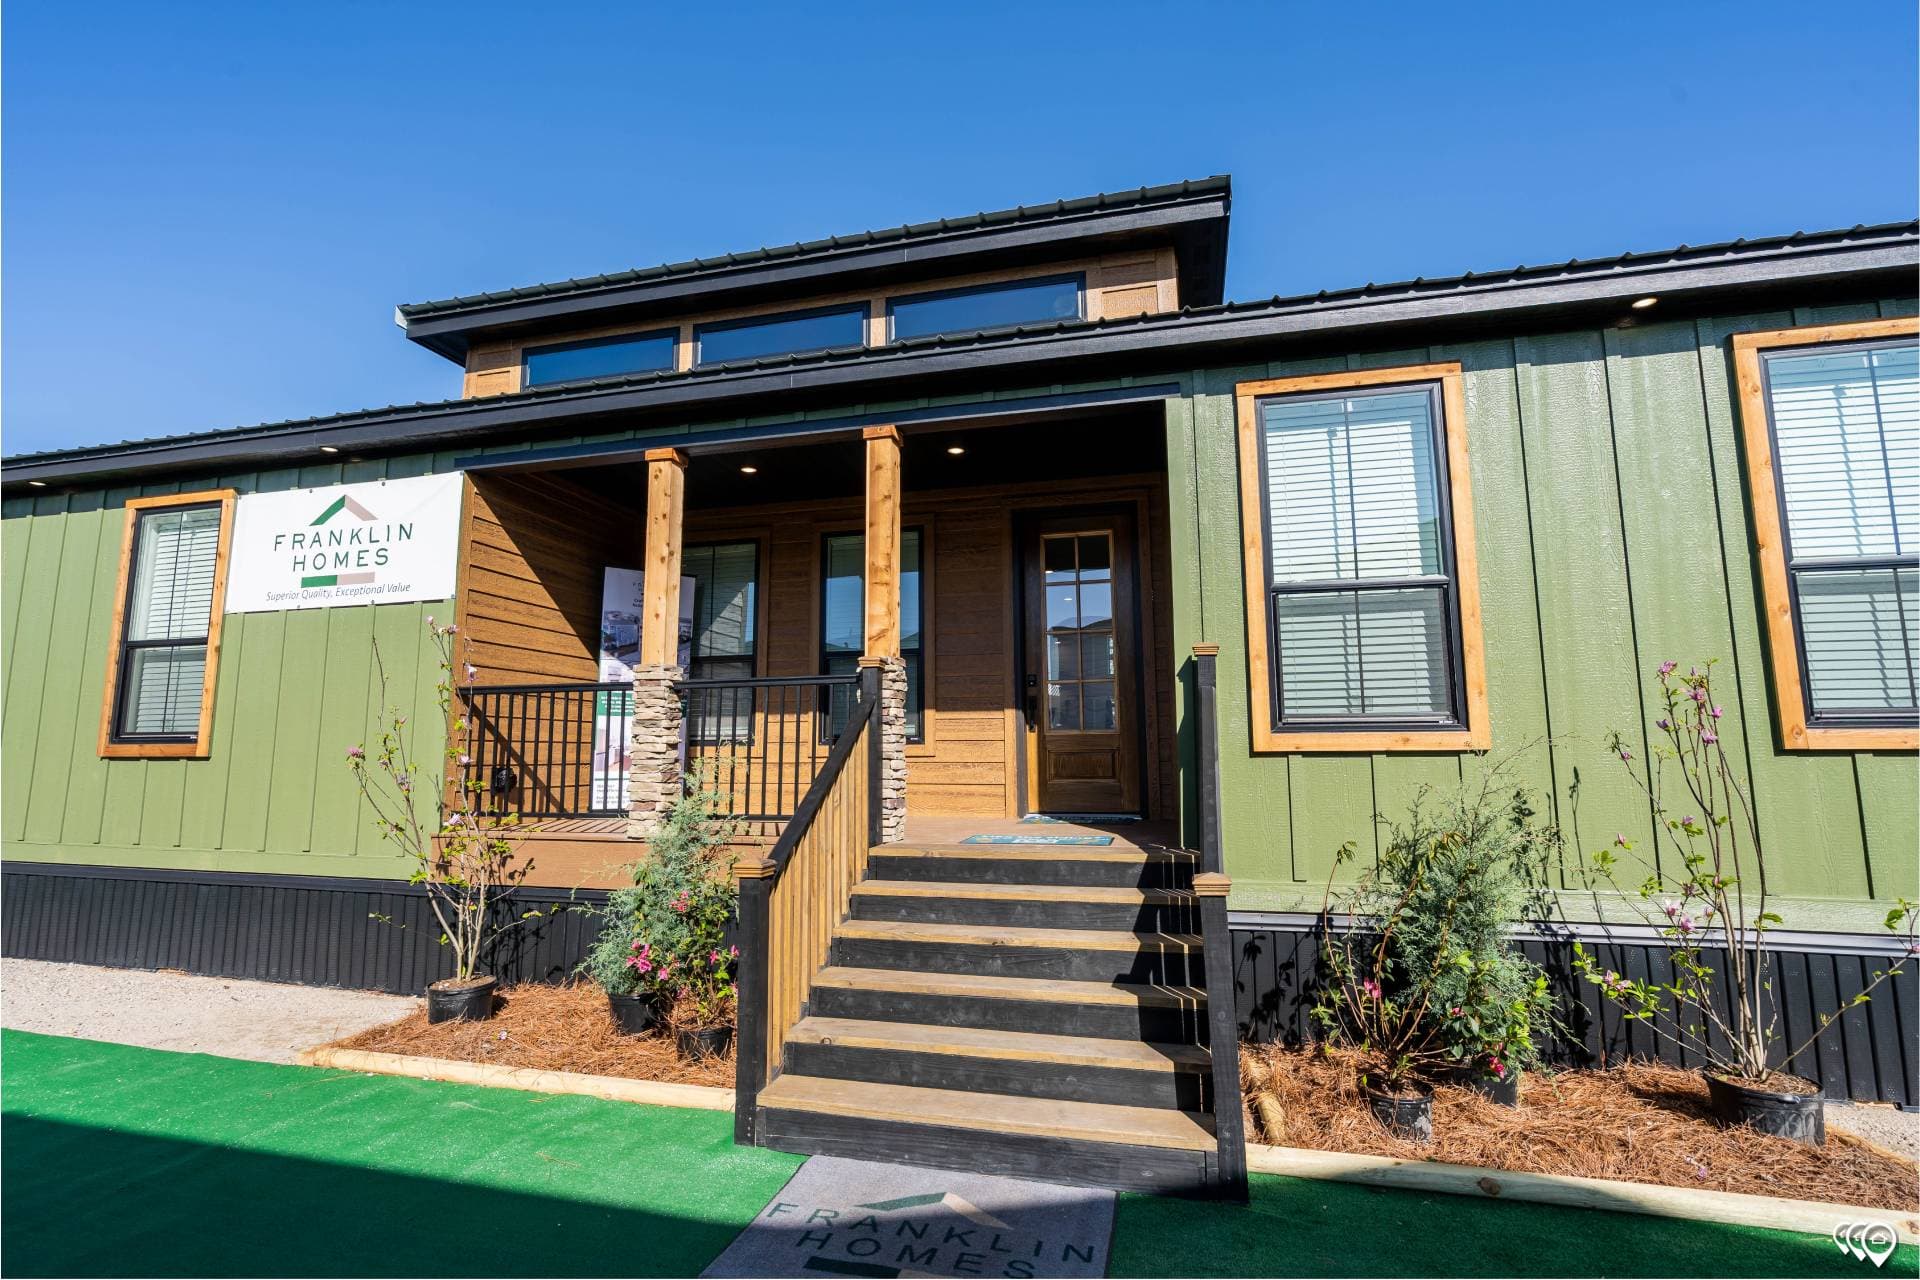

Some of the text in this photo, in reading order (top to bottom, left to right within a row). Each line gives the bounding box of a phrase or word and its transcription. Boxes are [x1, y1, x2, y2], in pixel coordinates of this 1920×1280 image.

[274, 523, 413, 551] FRANKLIN
[293, 547, 389, 572] HOMES
[266, 583, 412, 602] Superior Quality, Exceptional Value
[767, 1202, 1094, 1264] FRANKLIN
[796, 1230, 1035, 1279] HOMES
